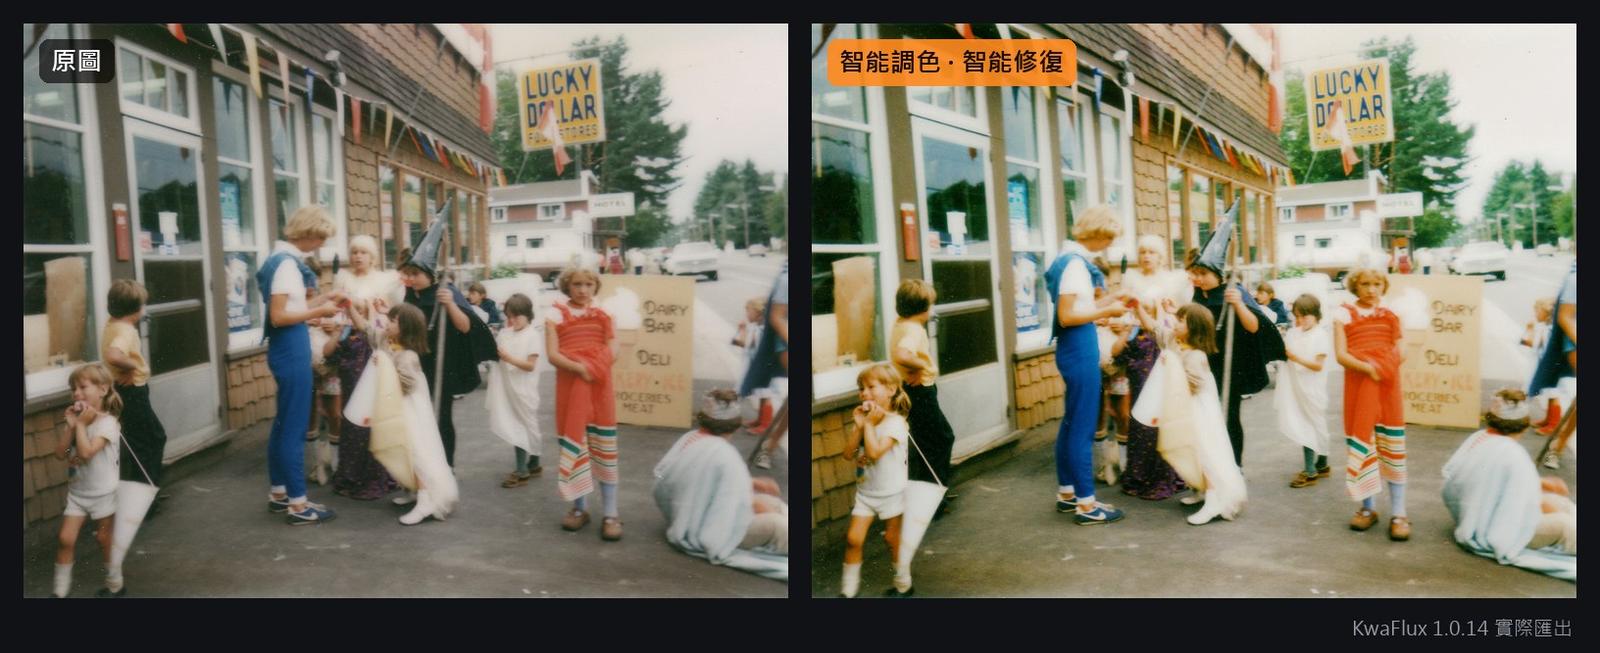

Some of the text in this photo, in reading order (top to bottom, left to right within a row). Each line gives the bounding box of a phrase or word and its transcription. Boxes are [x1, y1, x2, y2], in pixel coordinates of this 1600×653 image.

[526, 64, 592, 99] LUCKY
[1314, 64, 1380, 99] LUCKY
[527, 94, 597, 128] DLAR
[1316, 94, 1385, 128] DLAR
[643, 300, 689, 316] DAIRY
[1431, 300, 1477, 316] DAIRY
[642, 318, 676, 333] BAR
[1431, 318, 1464, 333] BAR
[636, 349, 670, 366] DELI
[1425, 349, 1459, 366] DELI
[623, 402, 655, 414] MEAT
